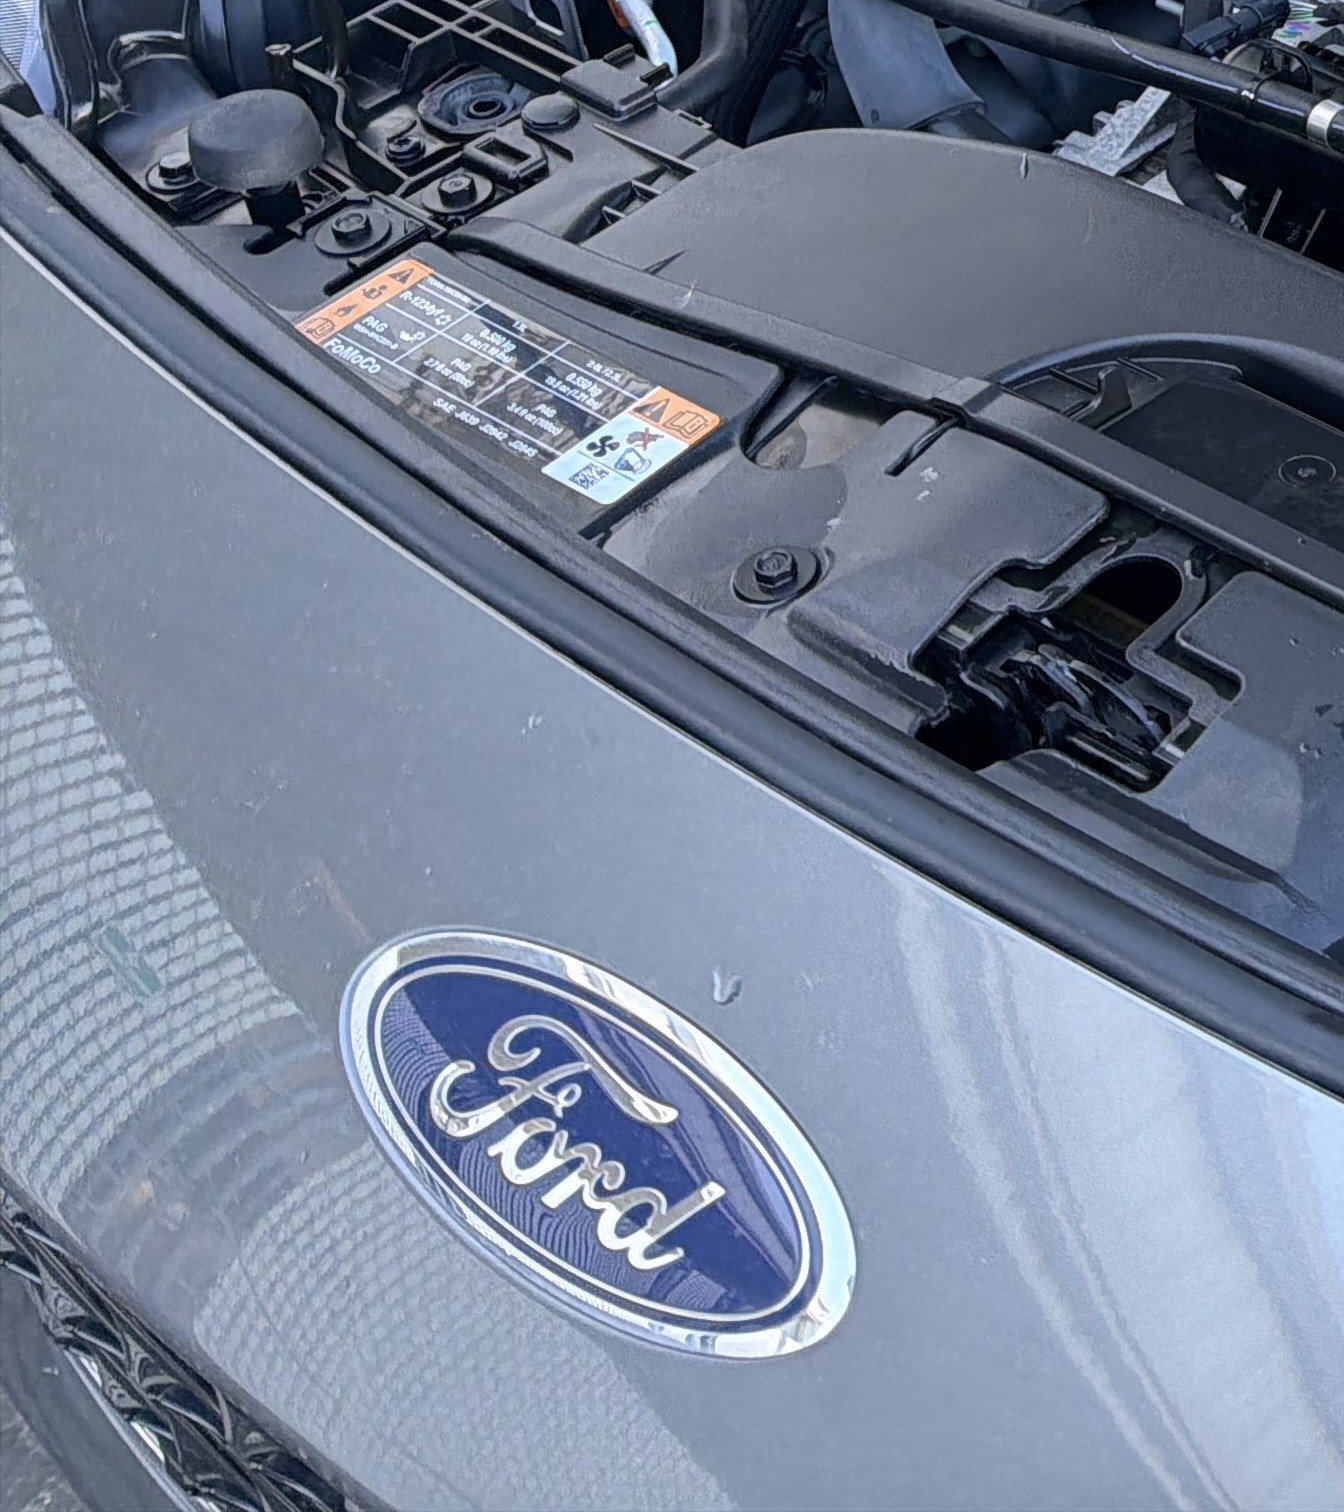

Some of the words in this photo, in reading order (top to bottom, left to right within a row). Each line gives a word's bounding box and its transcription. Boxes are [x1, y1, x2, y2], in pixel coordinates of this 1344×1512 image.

[399, 290, 445, 318] R-1234yf
[363, 316, 388, 332] PAG
[323, 337, 381, 374] FoMoCo
[433, 398, 456, 413] SAE
[429, 1014, 727, 1273] Ford
